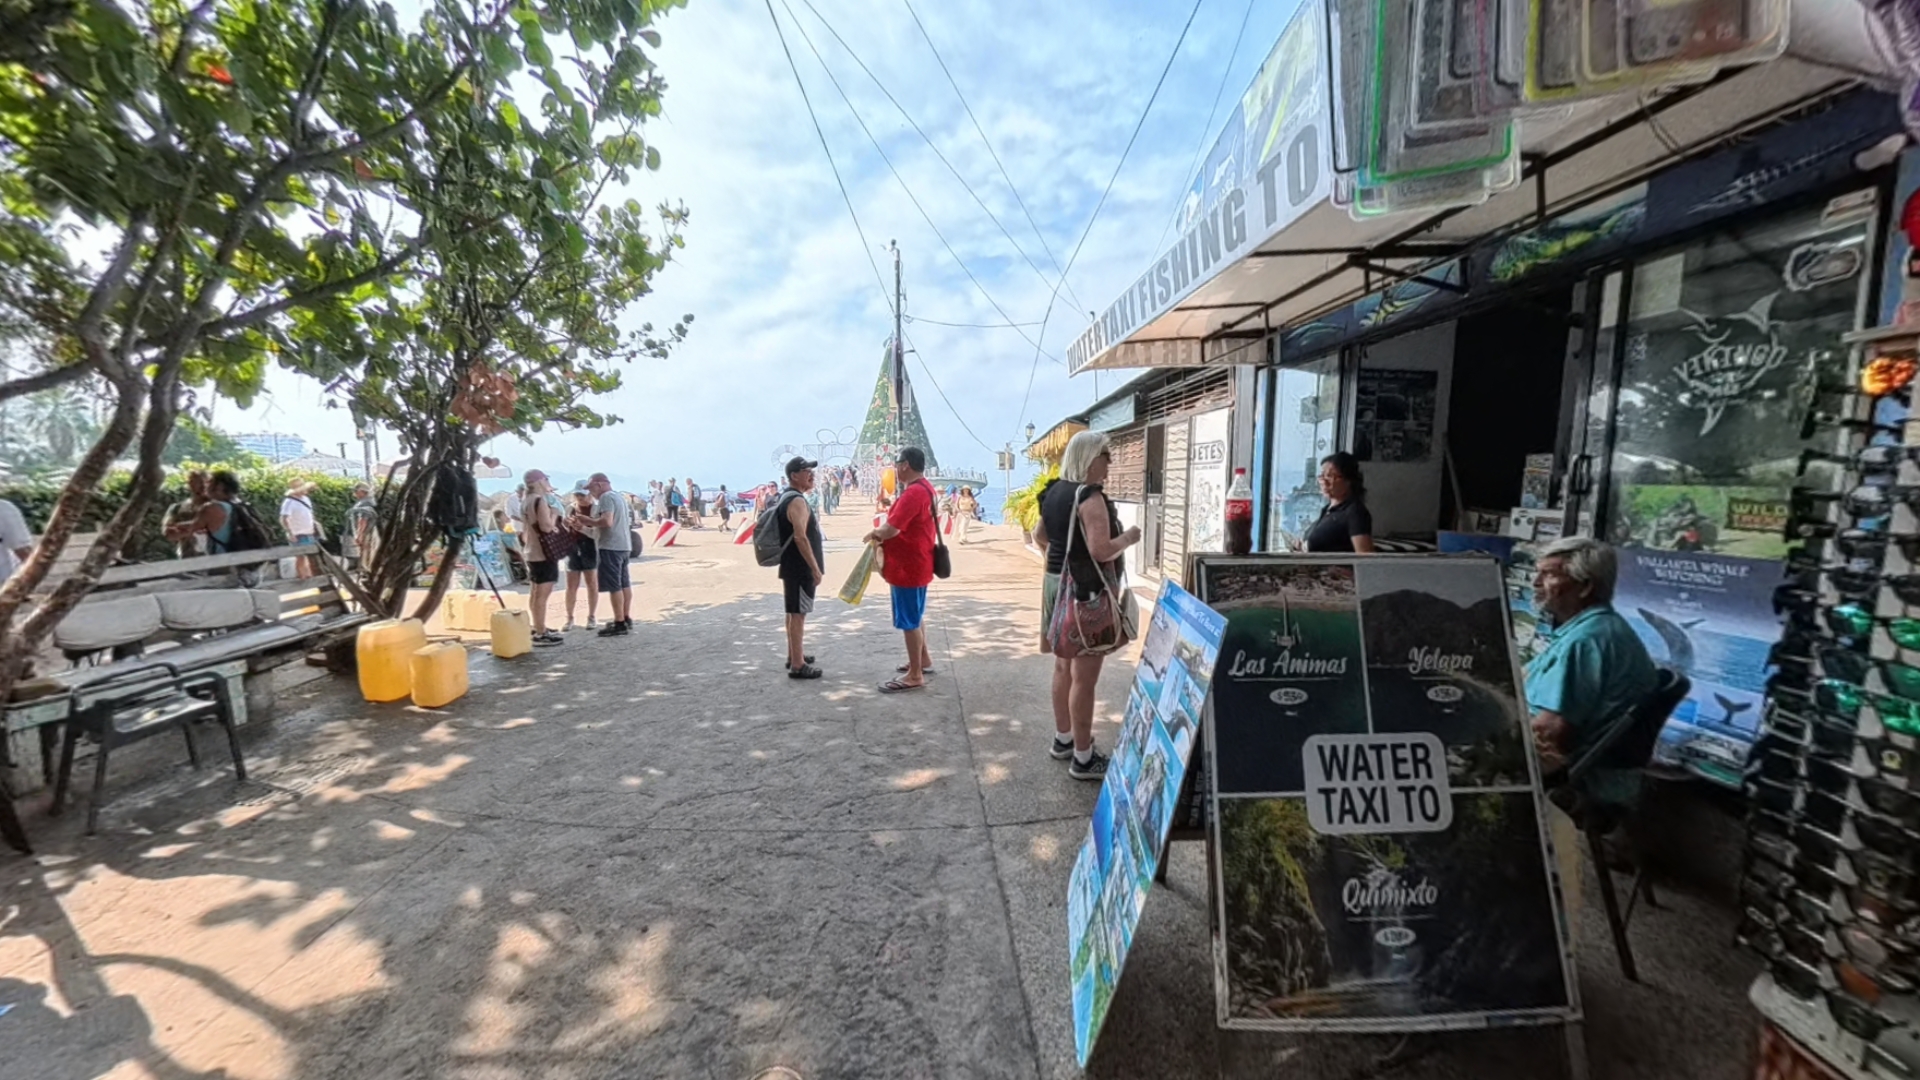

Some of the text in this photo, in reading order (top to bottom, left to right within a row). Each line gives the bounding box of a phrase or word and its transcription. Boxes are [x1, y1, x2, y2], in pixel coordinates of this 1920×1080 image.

[1066, 319, 1103, 374] WATER
[1100, 288, 1137, 347] TAXI
[1137, 188, 1247, 321] FISHING
[1256, 123, 1320, 230] TO
[1227, 649, 1266, 676] Las
[1408, 645, 1474, 675] Yelapa
[1317, 742, 1433, 781] WATER
[1317, 784, 1440, 825] TAXI TO
[1342, 876, 1438, 914] Quimixto
